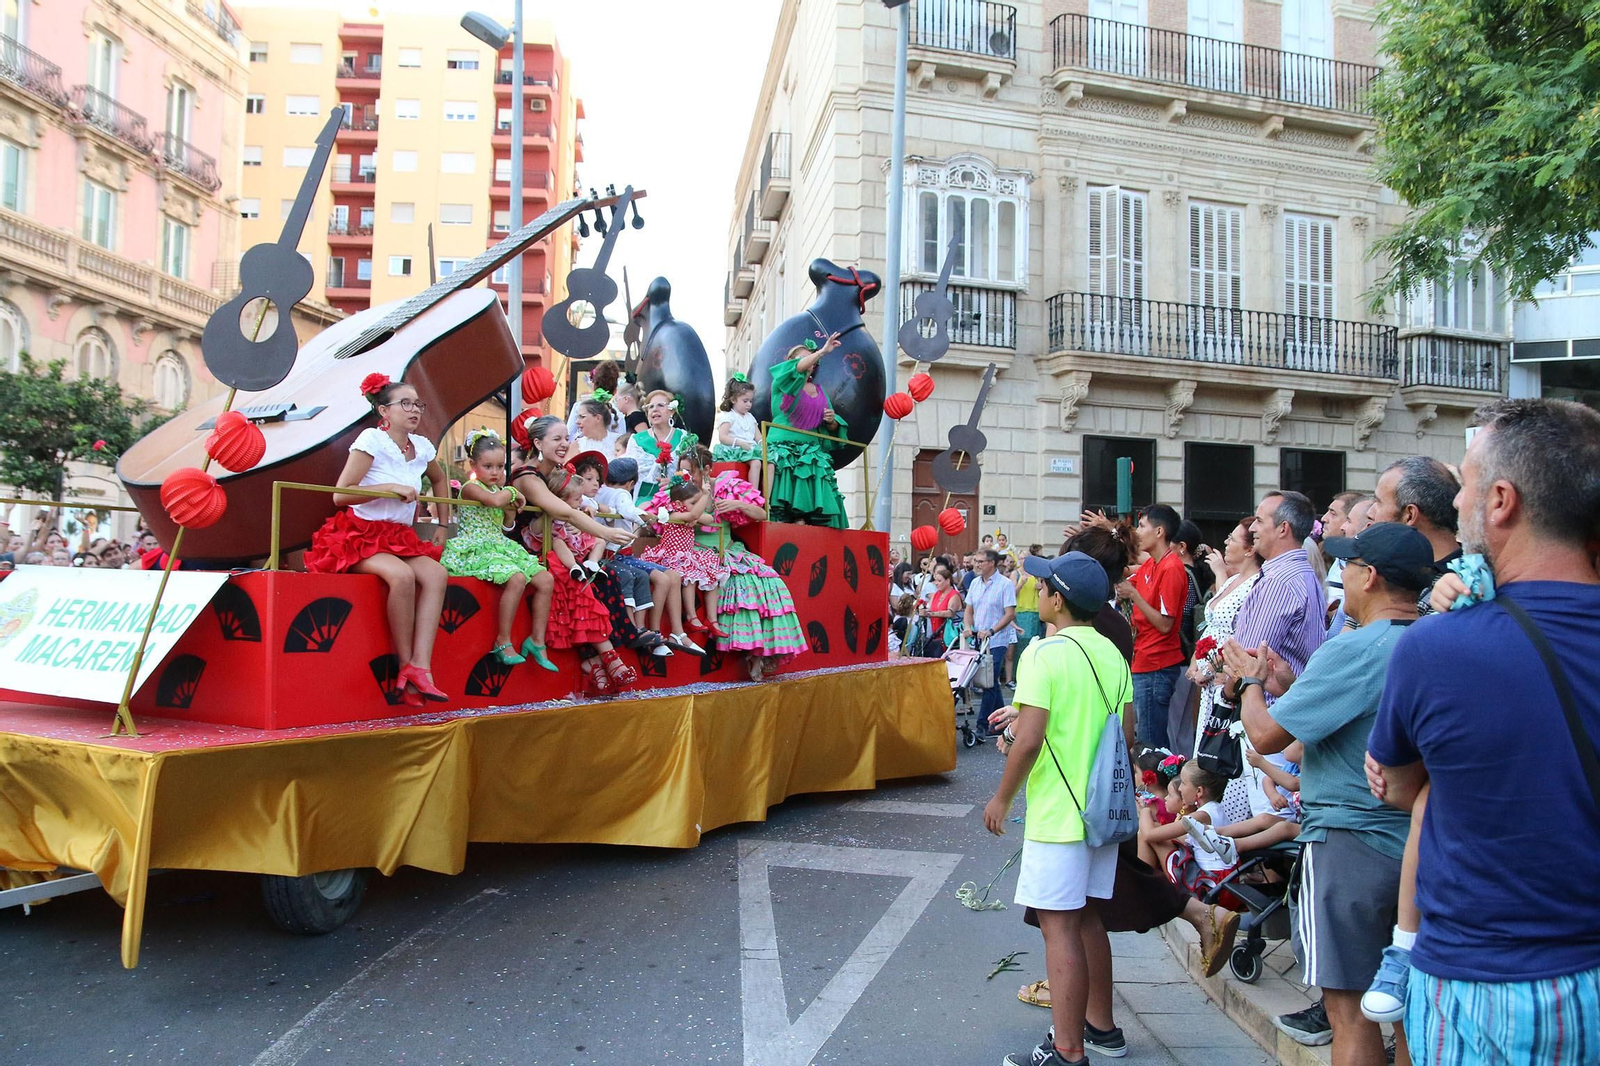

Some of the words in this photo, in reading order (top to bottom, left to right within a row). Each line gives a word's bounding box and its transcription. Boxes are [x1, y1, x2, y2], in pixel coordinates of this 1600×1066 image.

[986, 505, 993, 515] 6
[38, 598, 197, 633] HERMANDAD
[15, 633, 157, 672] MACARENA
